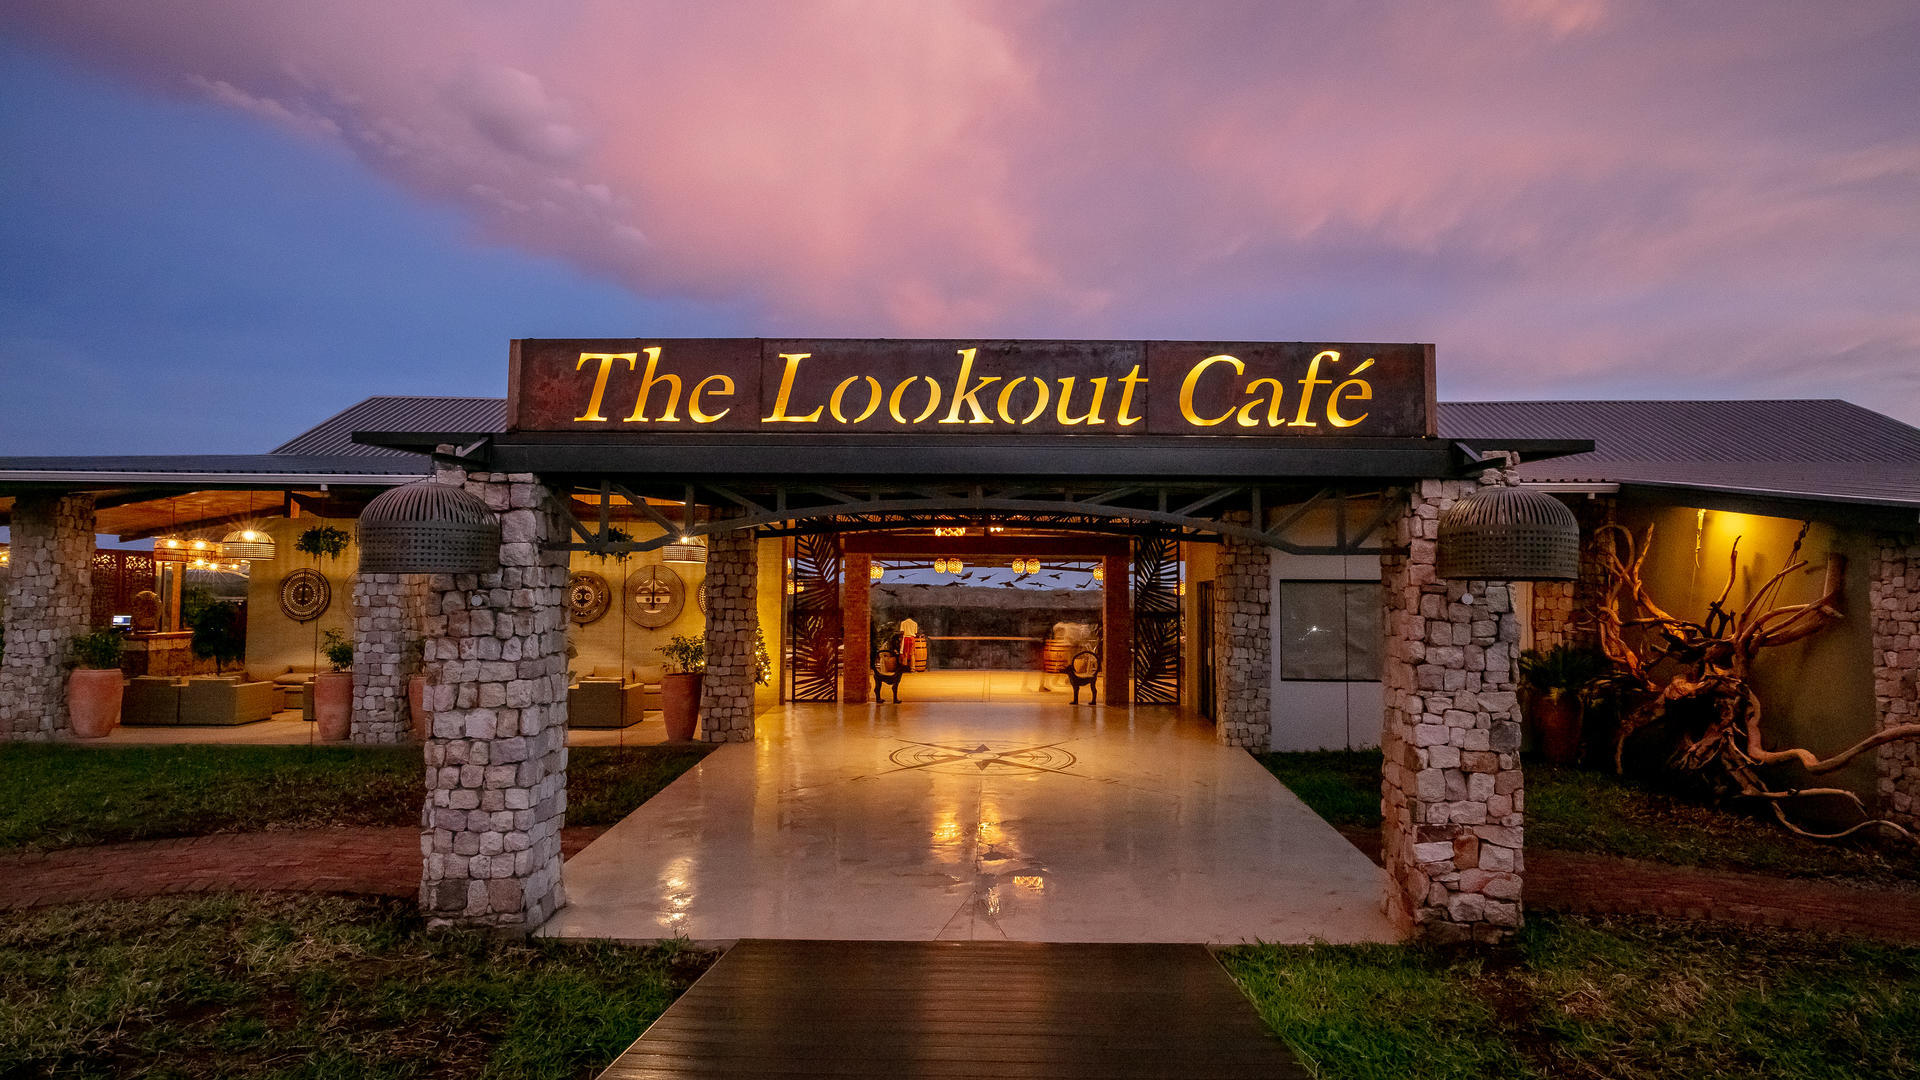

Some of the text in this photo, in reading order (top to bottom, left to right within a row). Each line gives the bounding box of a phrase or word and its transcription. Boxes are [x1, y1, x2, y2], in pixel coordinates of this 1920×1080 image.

[573, 346, 1375, 428] The Lookout Café
